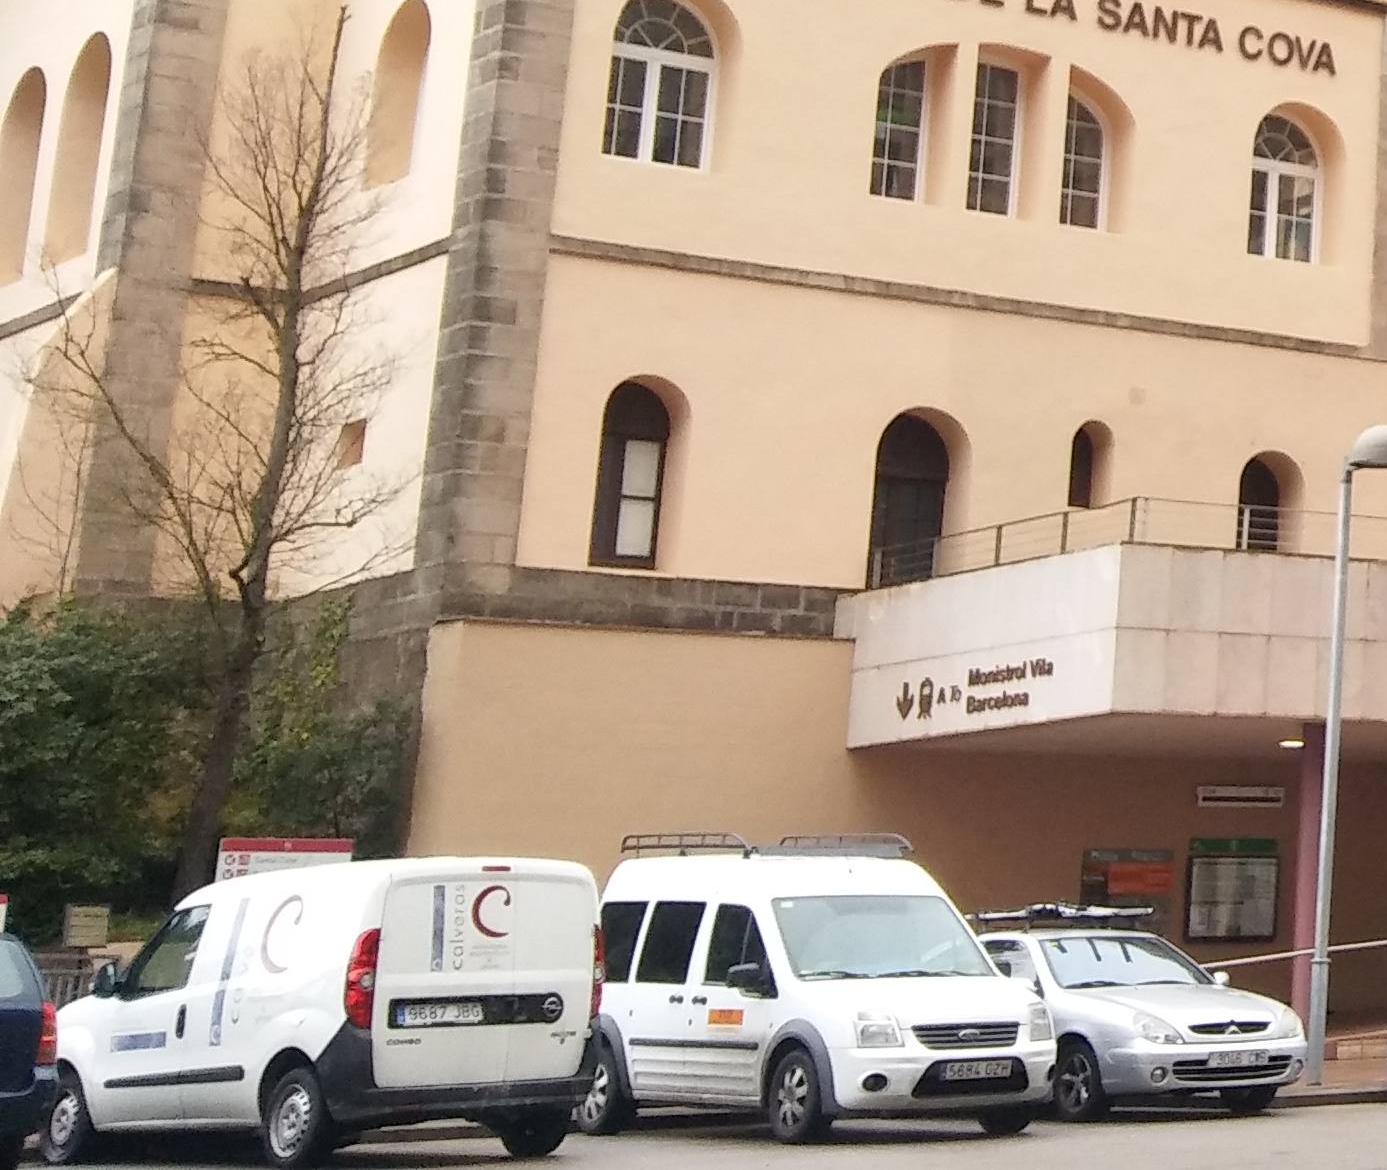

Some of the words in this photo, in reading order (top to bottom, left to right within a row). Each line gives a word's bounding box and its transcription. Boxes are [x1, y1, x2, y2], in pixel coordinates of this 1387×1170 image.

[1238, 24, 1338, 77] COVA
[968, 661, 1027, 687] Monistrol
[1030, 657, 1055, 678] Vila
[937, 687, 946, 704] A
[950, 685, 962, 702] To
[966, 690, 1030, 714] Barcelona
[449, 884, 466, 971] calveras
[408, 1005, 447, 1021] 9687
[453, 1004, 480, 1019] JBG
